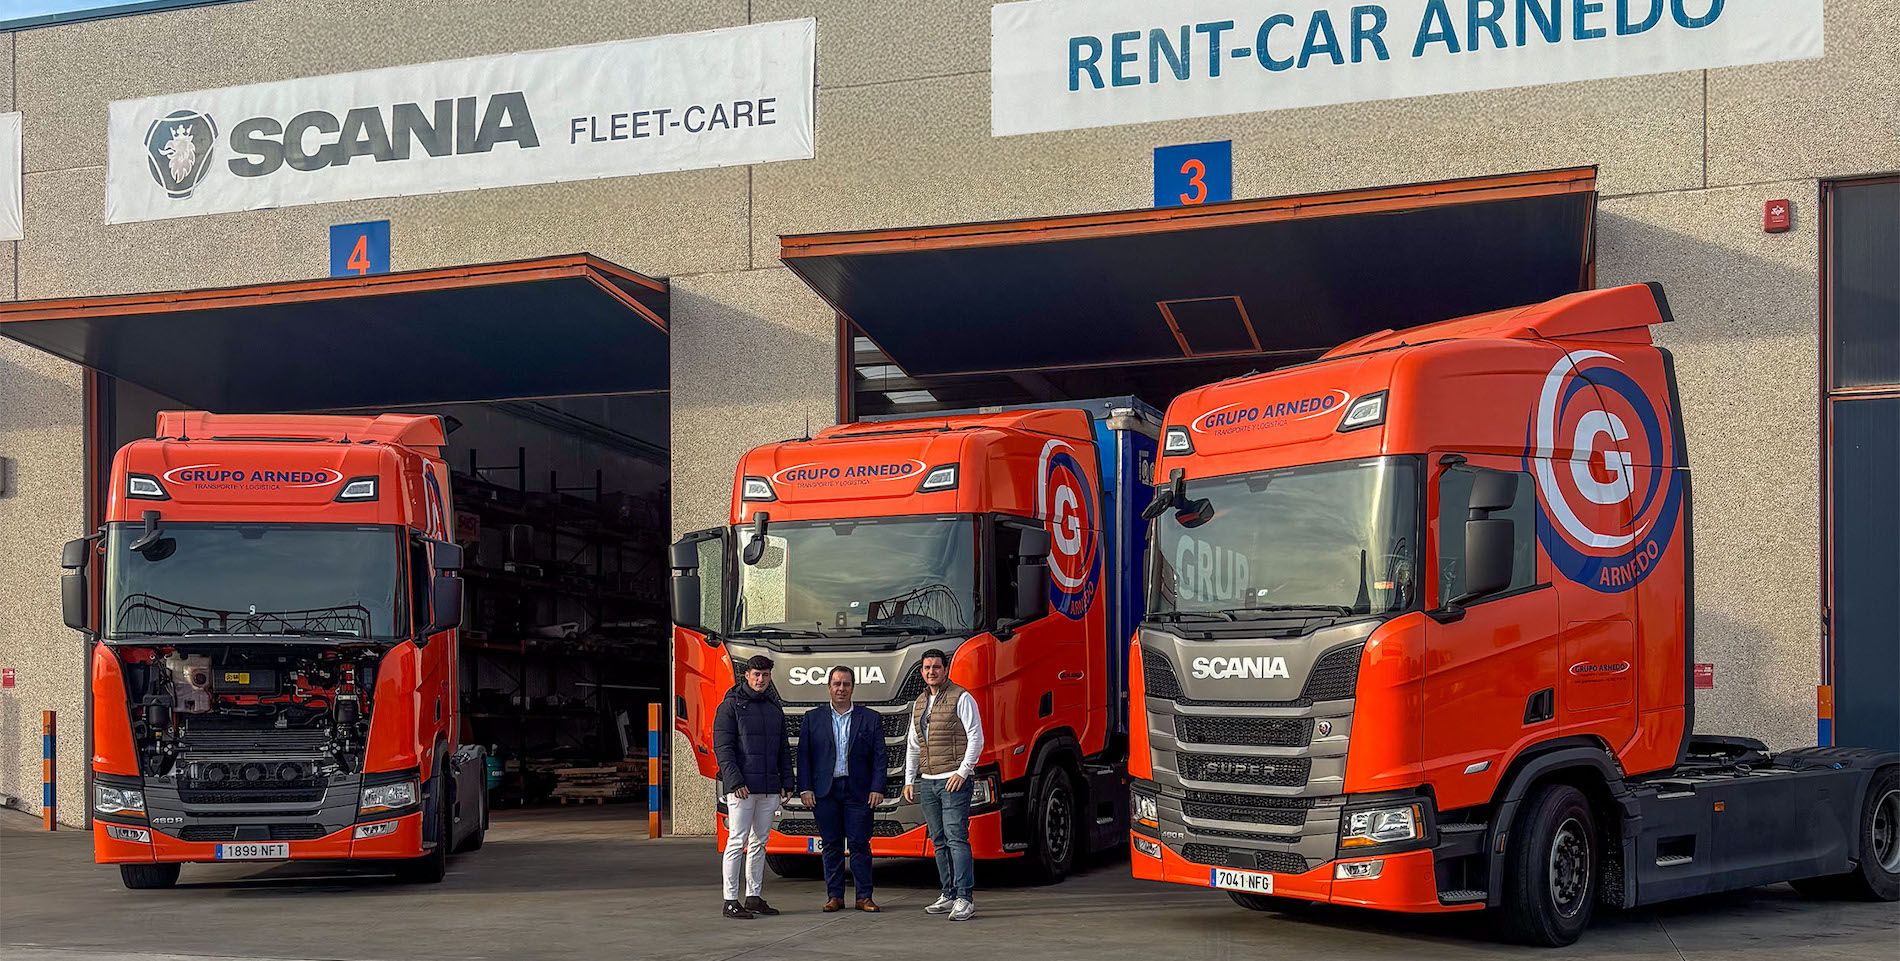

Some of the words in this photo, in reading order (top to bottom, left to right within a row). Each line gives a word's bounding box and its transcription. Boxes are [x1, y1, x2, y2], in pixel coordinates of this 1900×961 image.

[1069, 5, 1390, 91] RENT-CAR
[228, 91, 541, 177] SCANIA
[571, 97, 776, 144] FLEET-CARE
[1180, 159, 1207, 205] 3
[347, 235, 370, 276] 4
[1205, 408, 1259, 428] GRUPO
[1263, 396, 1335, 419] ARNEDO
[786, 467, 841, 481] GRUPO
[845, 463, 913, 478] ARNEDO
[1570, 410, 1634, 504] G
[180, 470, 245, 482] GRUPO
[250, 471, 328, 483] ARNEDO
[1053, 484, 1081, 556] G
[1599, 539, 1659, 587] ARNEDO
[1192, 656, 1290, 679] SCANIA
[1574, 665, 1598, 673] GRUPO
[1206, 762, 1276, 776] SUPER
[228, 846, 258, 857] 1899
[261, 844, 284, 856] NFT
[1219, 872, 1245, 886] 7041
[1248, 877, 1269, 890] NFG
